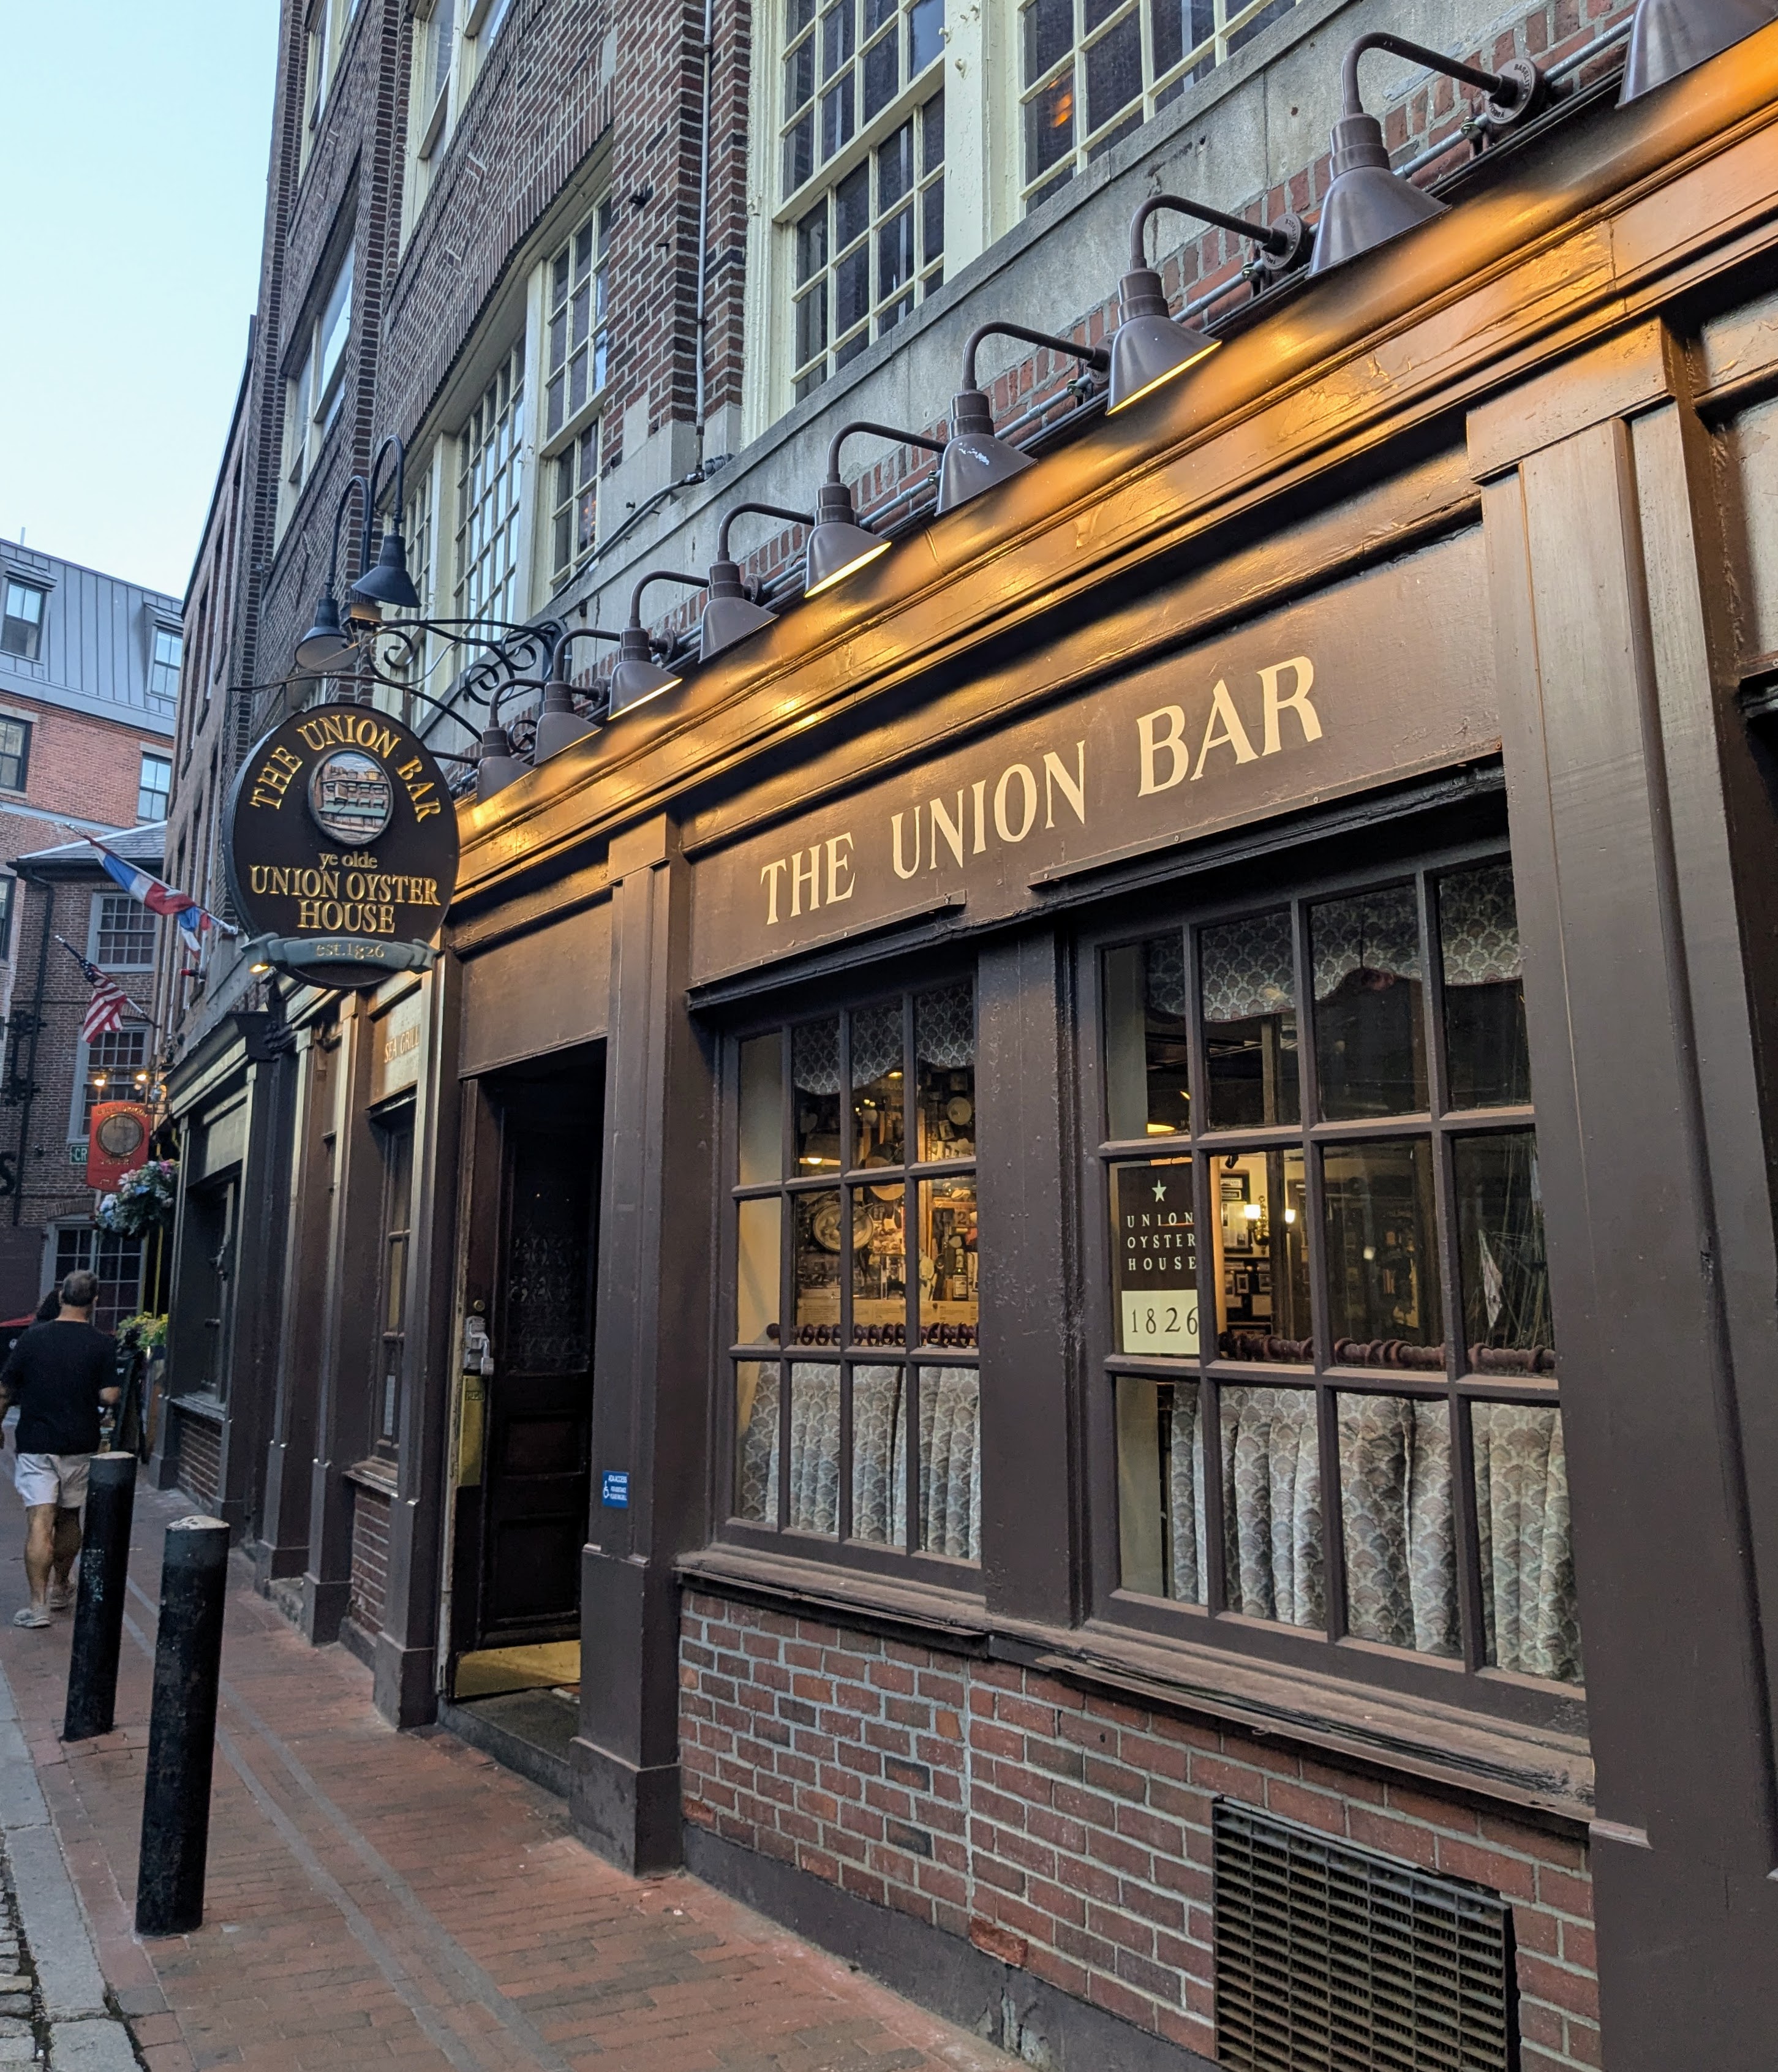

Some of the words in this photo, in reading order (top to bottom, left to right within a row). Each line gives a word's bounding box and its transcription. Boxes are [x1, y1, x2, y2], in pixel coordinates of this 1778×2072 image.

[1513, 64, 1531, 94] BASELITE
[249, 745, 303, 810] THE
[296, 714, 401, 759] UNION
[396, 755, 441, 823] BAR
[759, 832, 856, 925] THE
[891, 739, 1087, 880] UNION
[1136, 655, 1323, 798] BAR
[318, 852, 338, 871] ye
[342, 851, 378, 869] olde
[249, 864, 340, 899] UNION
[346, 873, 441, 906] OYSTER
[297, 898, 395, 933] HOUSE
[384, 1037, 397, 1063] SEA
[400, 1026, 420, 1054] GRILL
[1127, 1211, 1195, 1228] UNION
[1127, 1233, 1196, 1249] OYSTER
[1128, 1256, 1196, 1271] HOUSE
[1132, 1306, 1199, 1335] 1826
